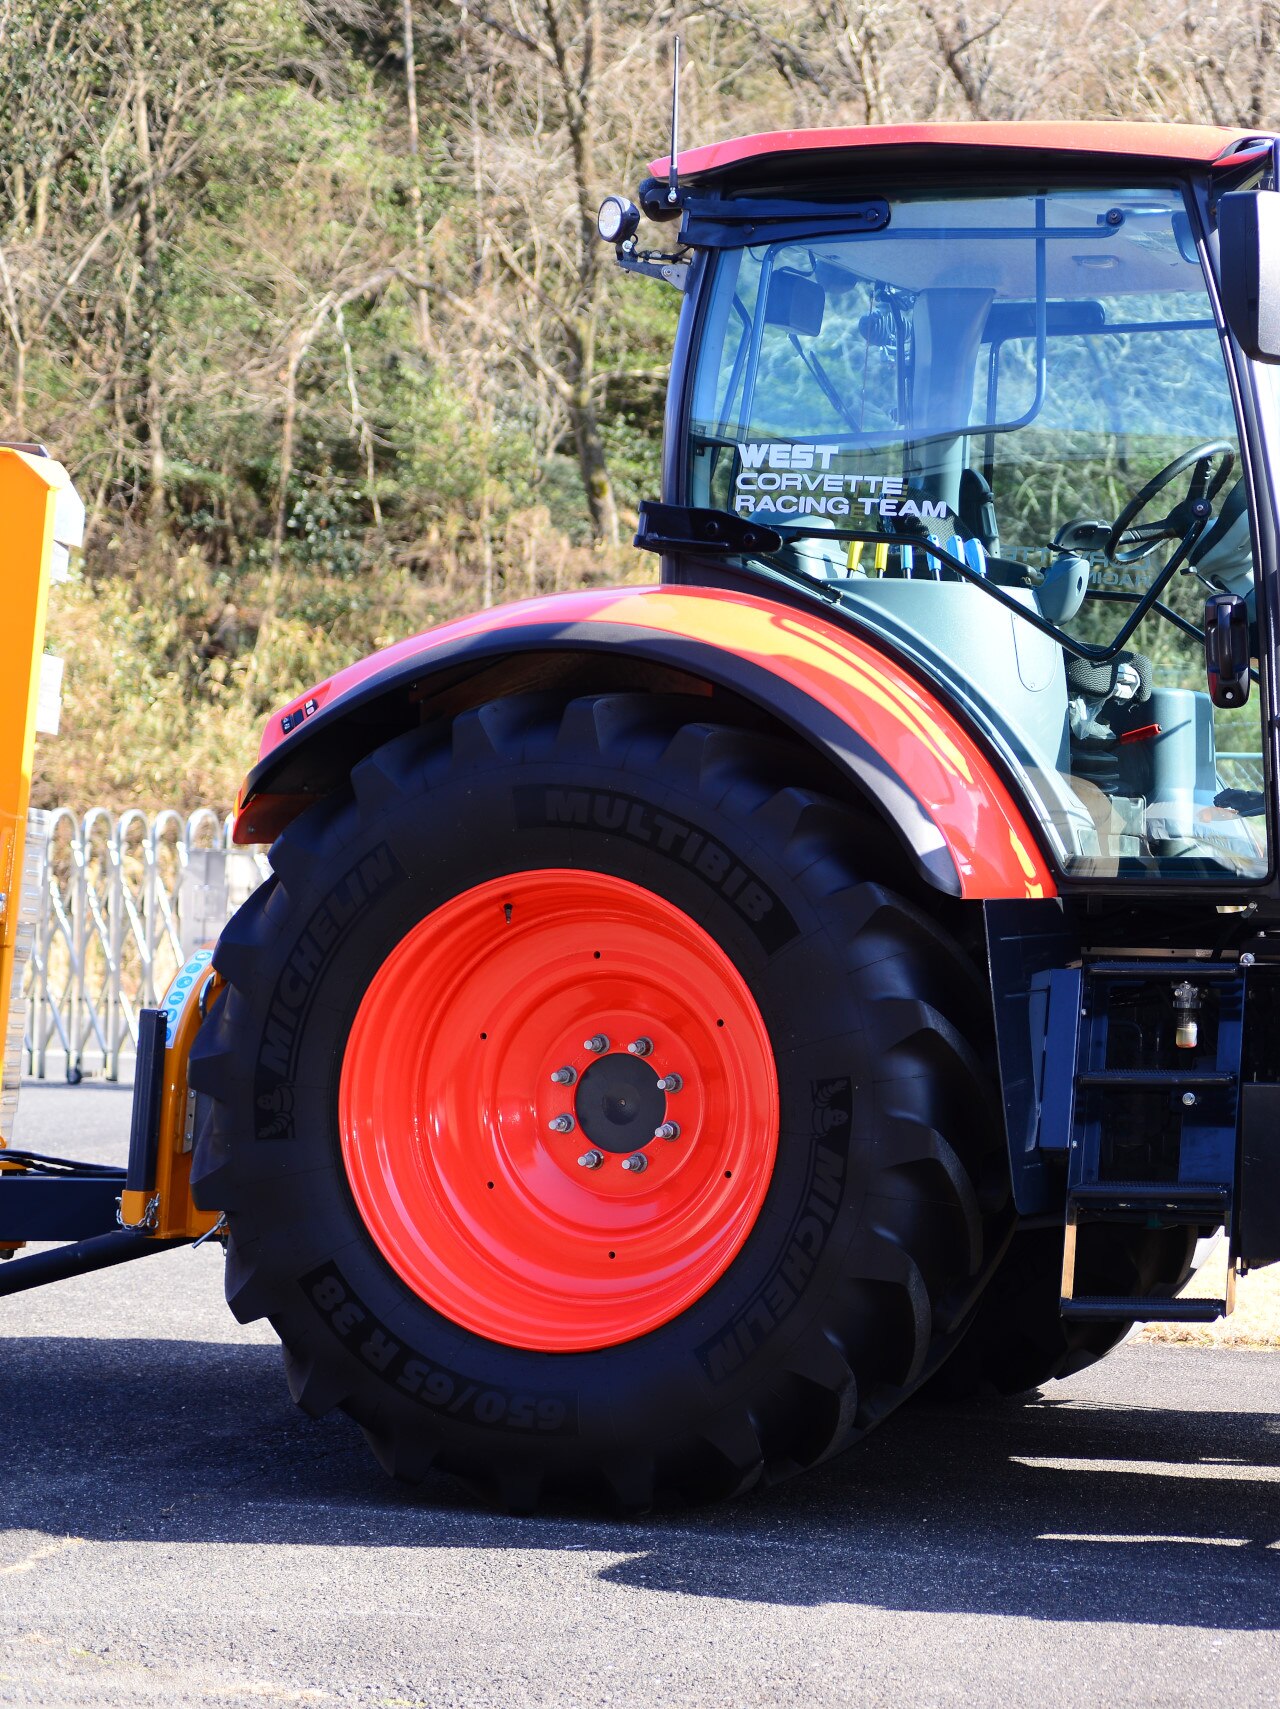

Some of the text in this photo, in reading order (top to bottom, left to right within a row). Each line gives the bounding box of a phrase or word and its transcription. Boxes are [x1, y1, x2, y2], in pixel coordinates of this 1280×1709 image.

[735, 495, 948, 518] RACING TEAM
[736, 472, 904, 495] CORVETTE
[738, 443, 839, 469] WEST
[546, 790, 773, 922] MULTIBIB
[259, 846, 395, 1077] MICHELIN
[706, 1143, 845, 1382] MICHELIN
[311, 1275, 566, 1430] 650/65 R 38
